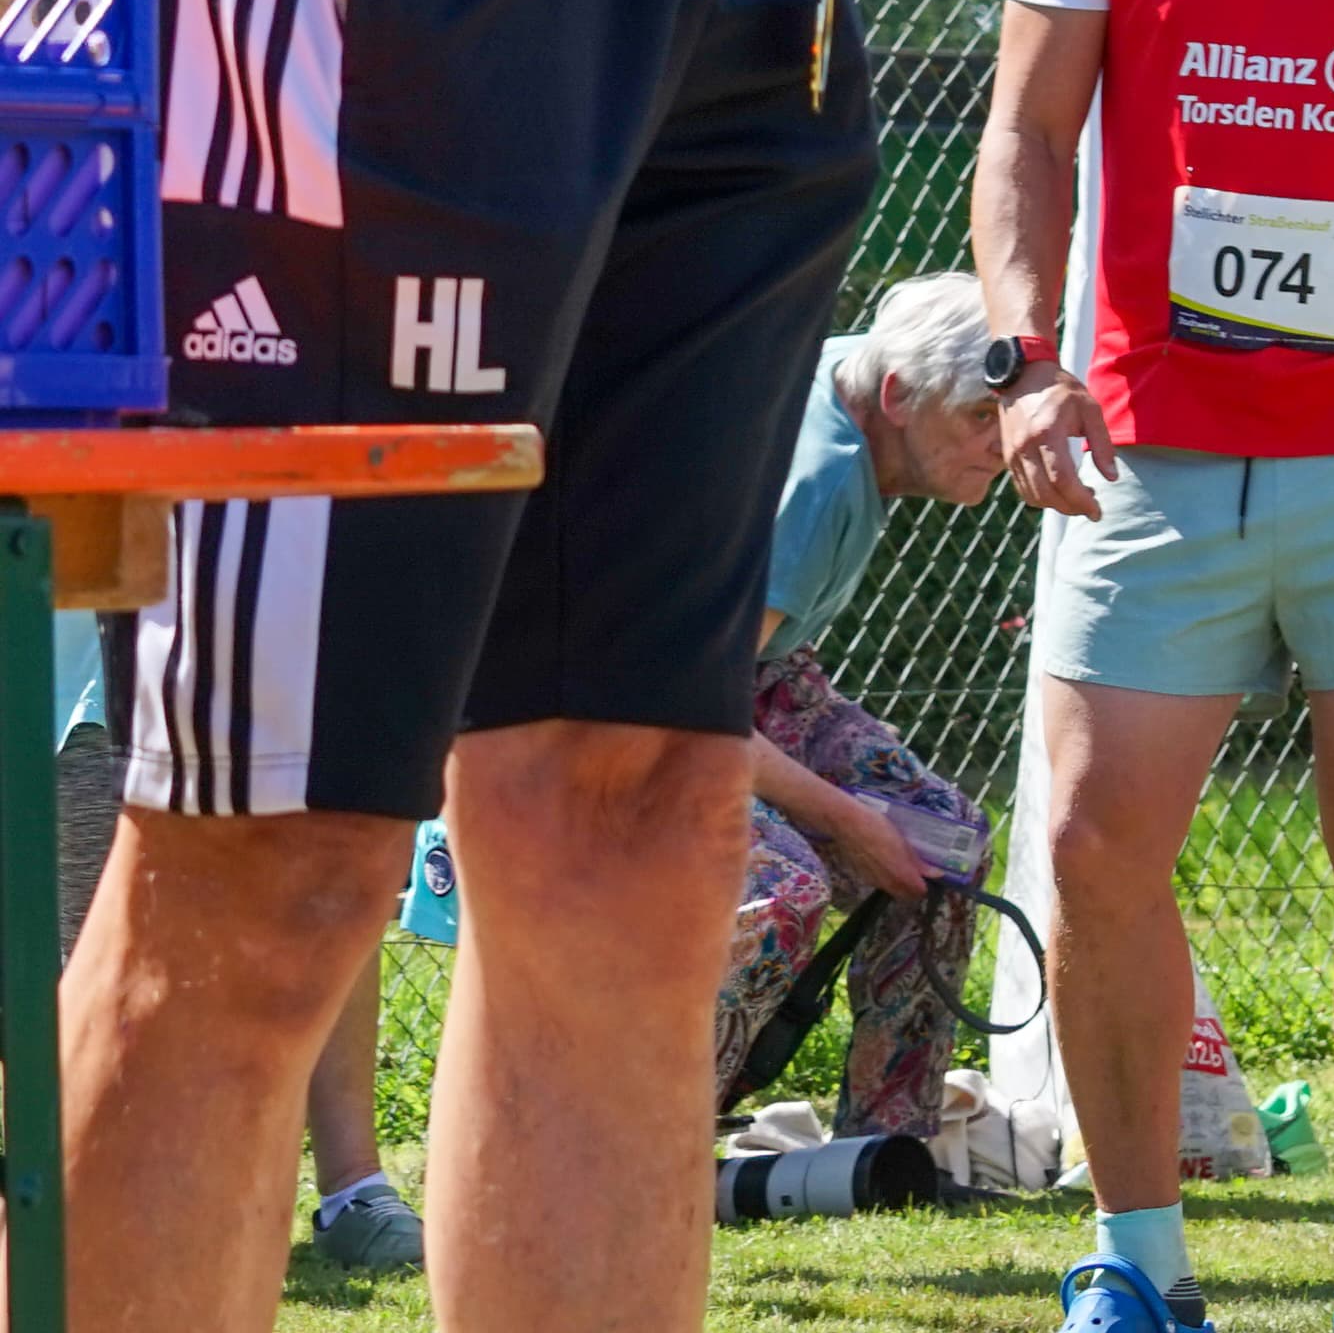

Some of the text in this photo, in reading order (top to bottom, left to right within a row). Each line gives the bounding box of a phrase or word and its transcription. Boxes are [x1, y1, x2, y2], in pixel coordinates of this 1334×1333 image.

[1179, 42, 1317, 85] Allianz
[1177, 95, 1294, 129] Torsden
[1214, 245, 1314, 304] 074
[184, 329, 297, 365] adidas
[392, 275, 505, 393] HL
